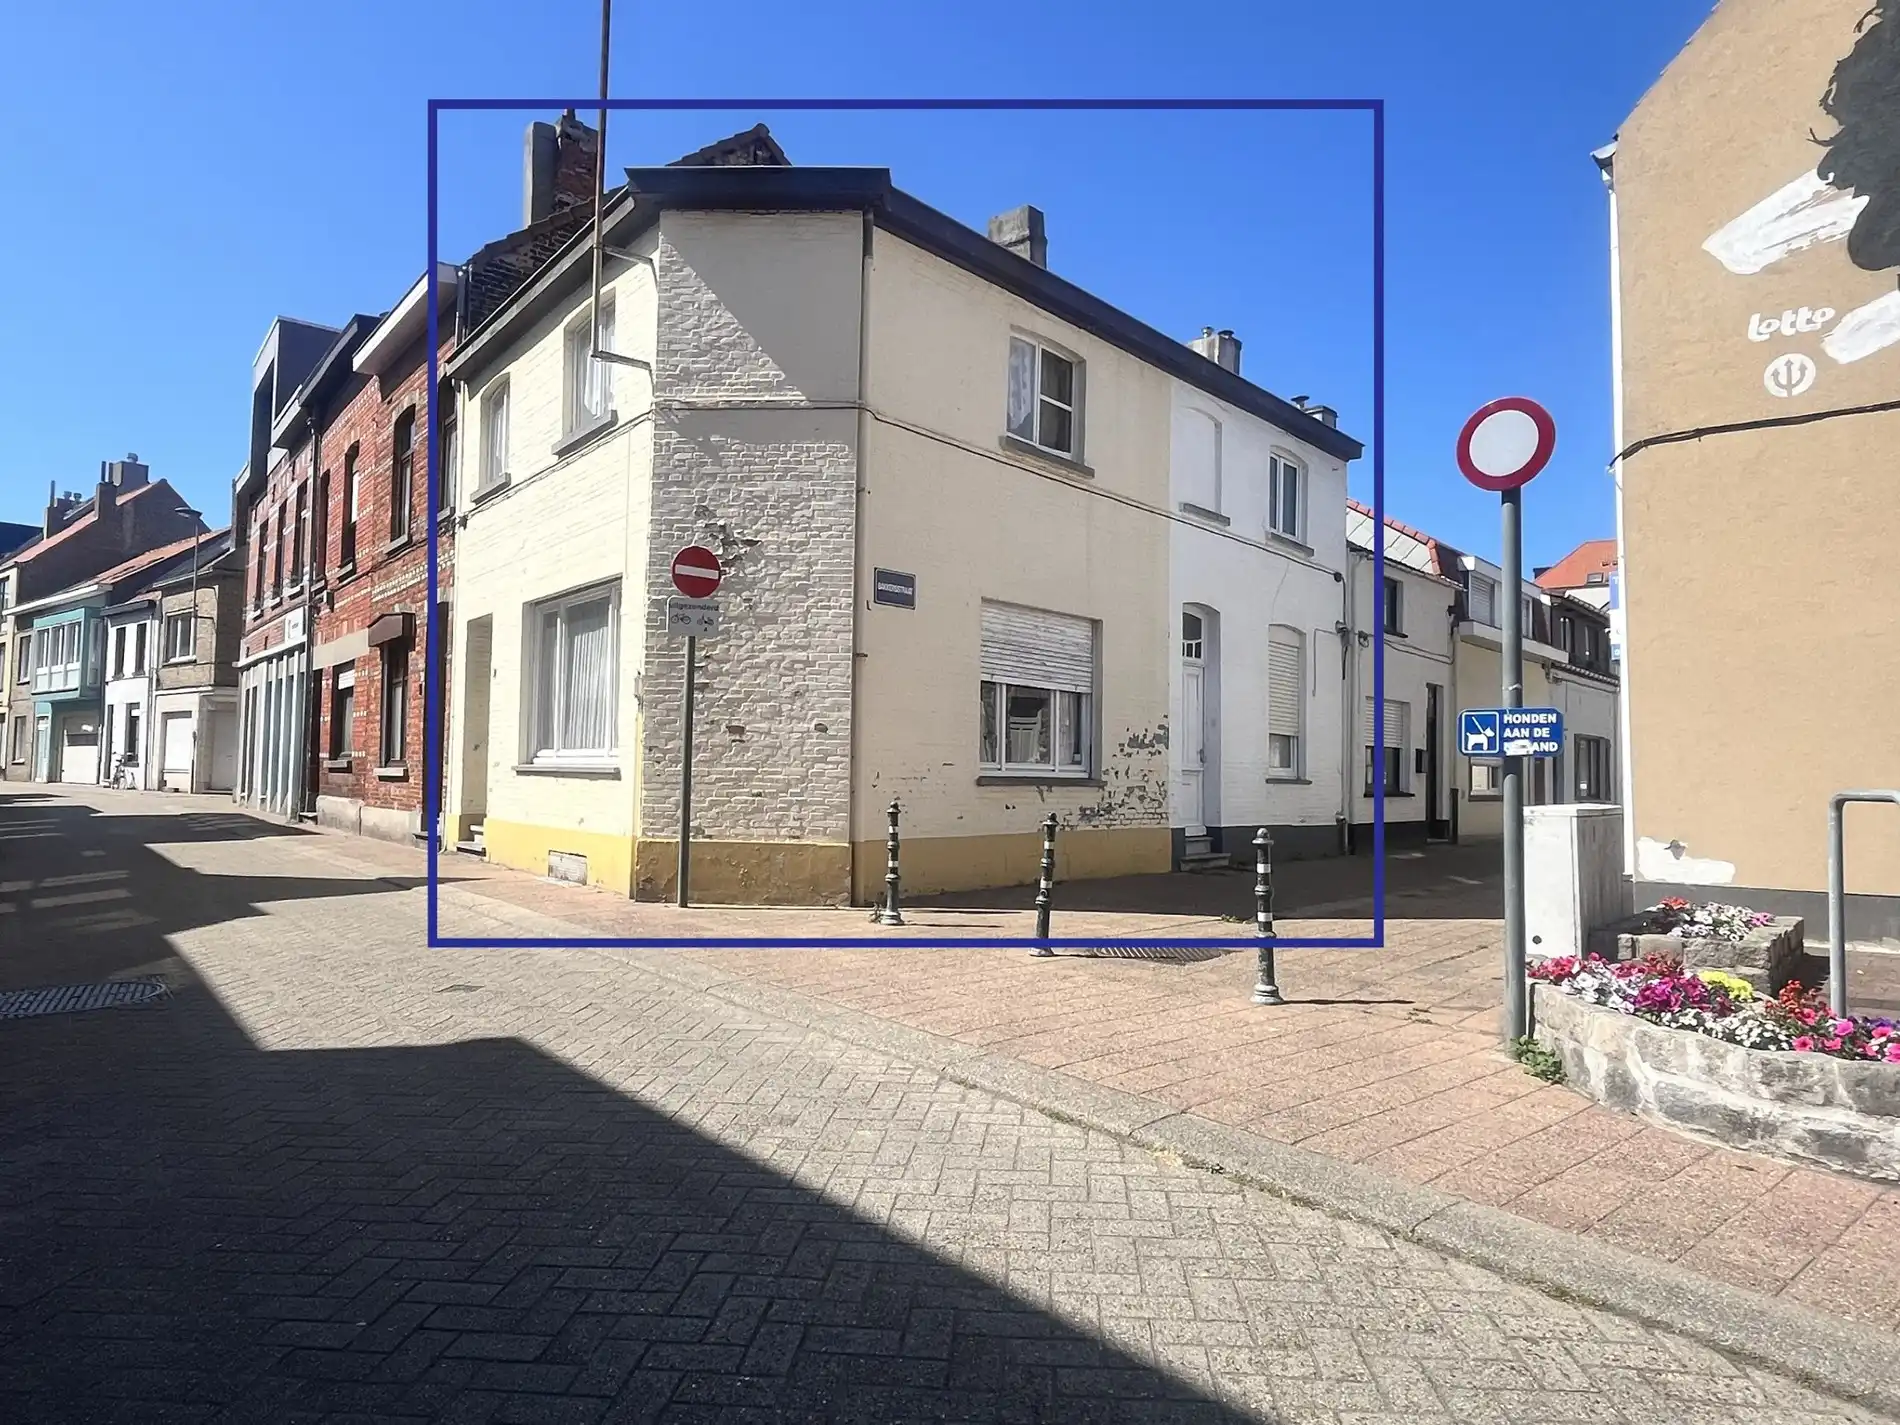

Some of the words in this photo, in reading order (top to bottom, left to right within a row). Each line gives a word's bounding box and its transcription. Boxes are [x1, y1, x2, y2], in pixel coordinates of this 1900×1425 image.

[1503, 713, 1557, 724] HONDEN
[1503, 727, 1530, 738] AAN
[1533, 727, 1550, 738] DE
